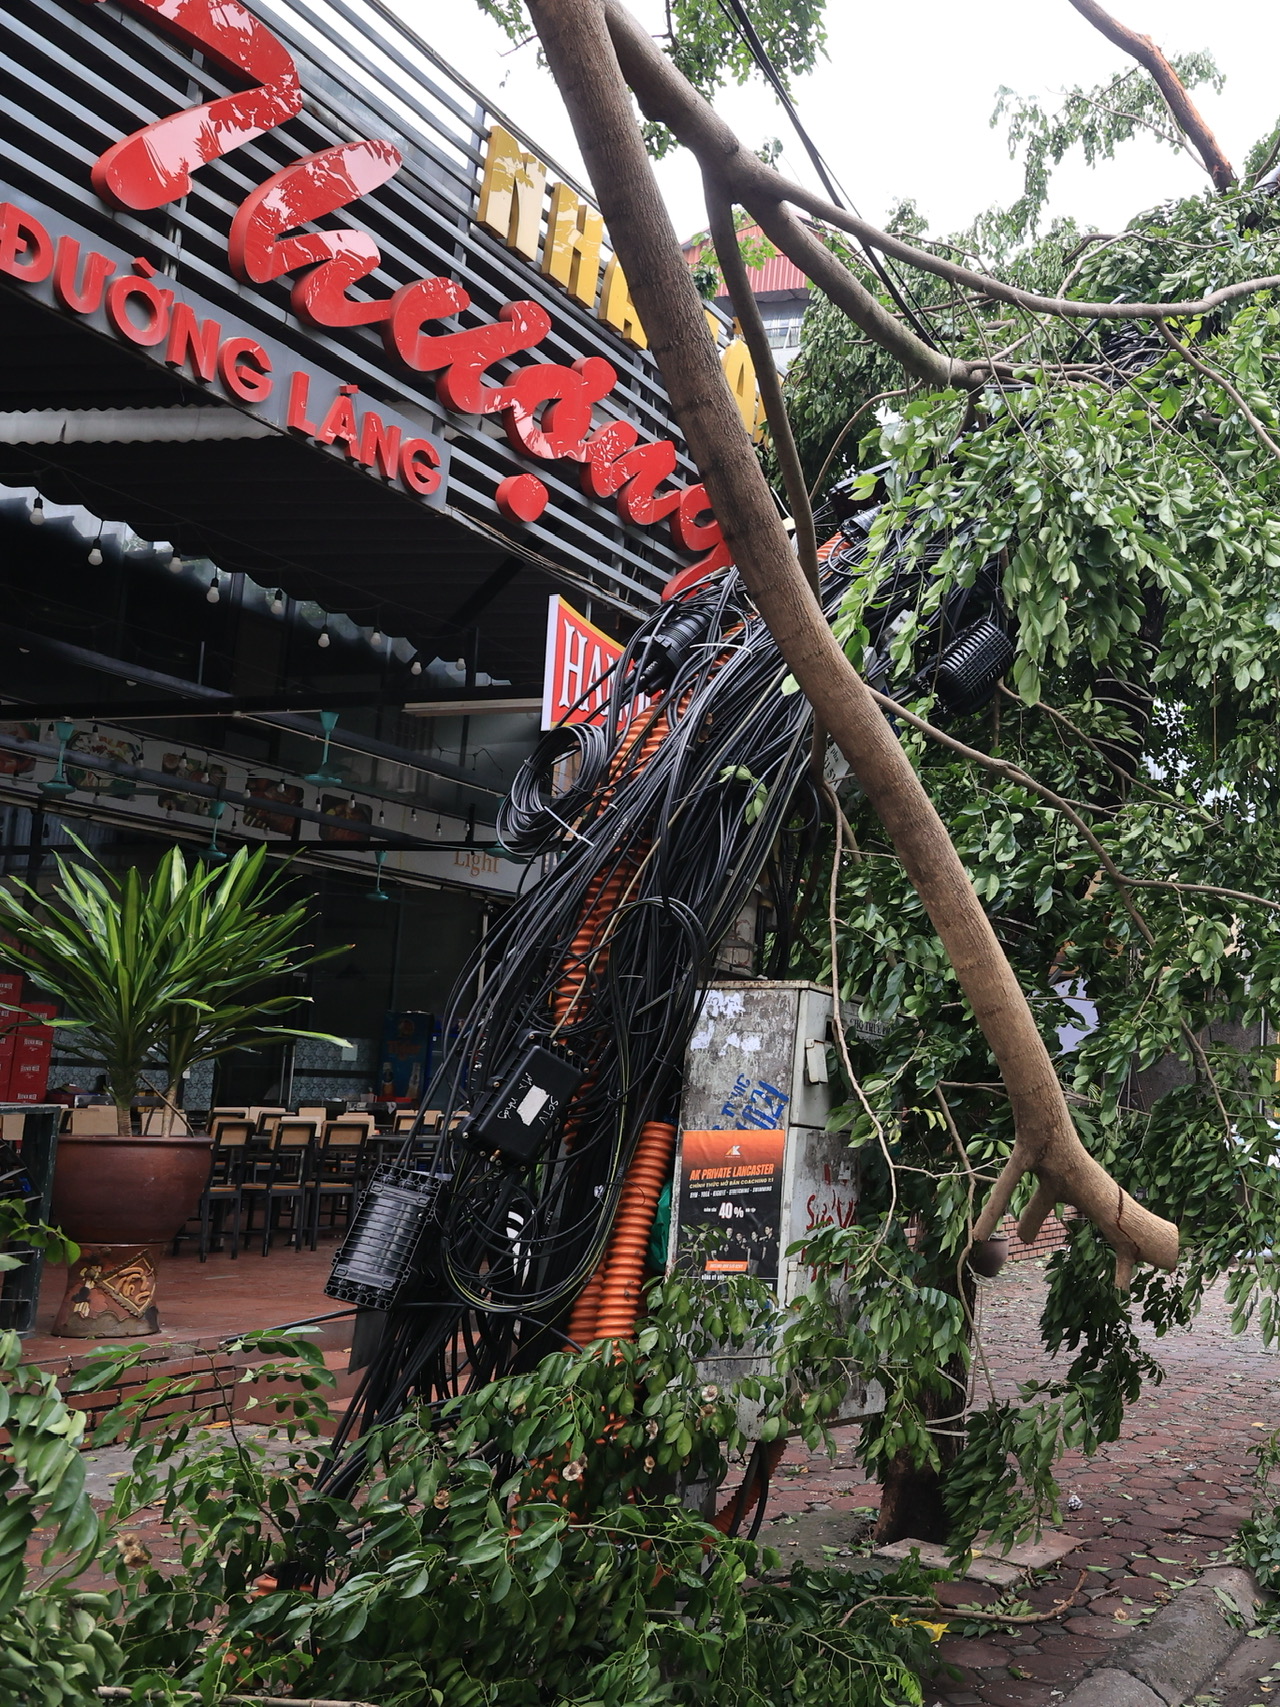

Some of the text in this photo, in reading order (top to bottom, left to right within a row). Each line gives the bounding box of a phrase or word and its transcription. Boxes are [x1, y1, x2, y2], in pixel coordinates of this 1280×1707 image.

[0, 202, 441, 495] ĐƯỜNG LÁNG
[454, 850, 501, 877] Light
[689, 1163, 775, 1181] AK PRIVATE LANCASTER
